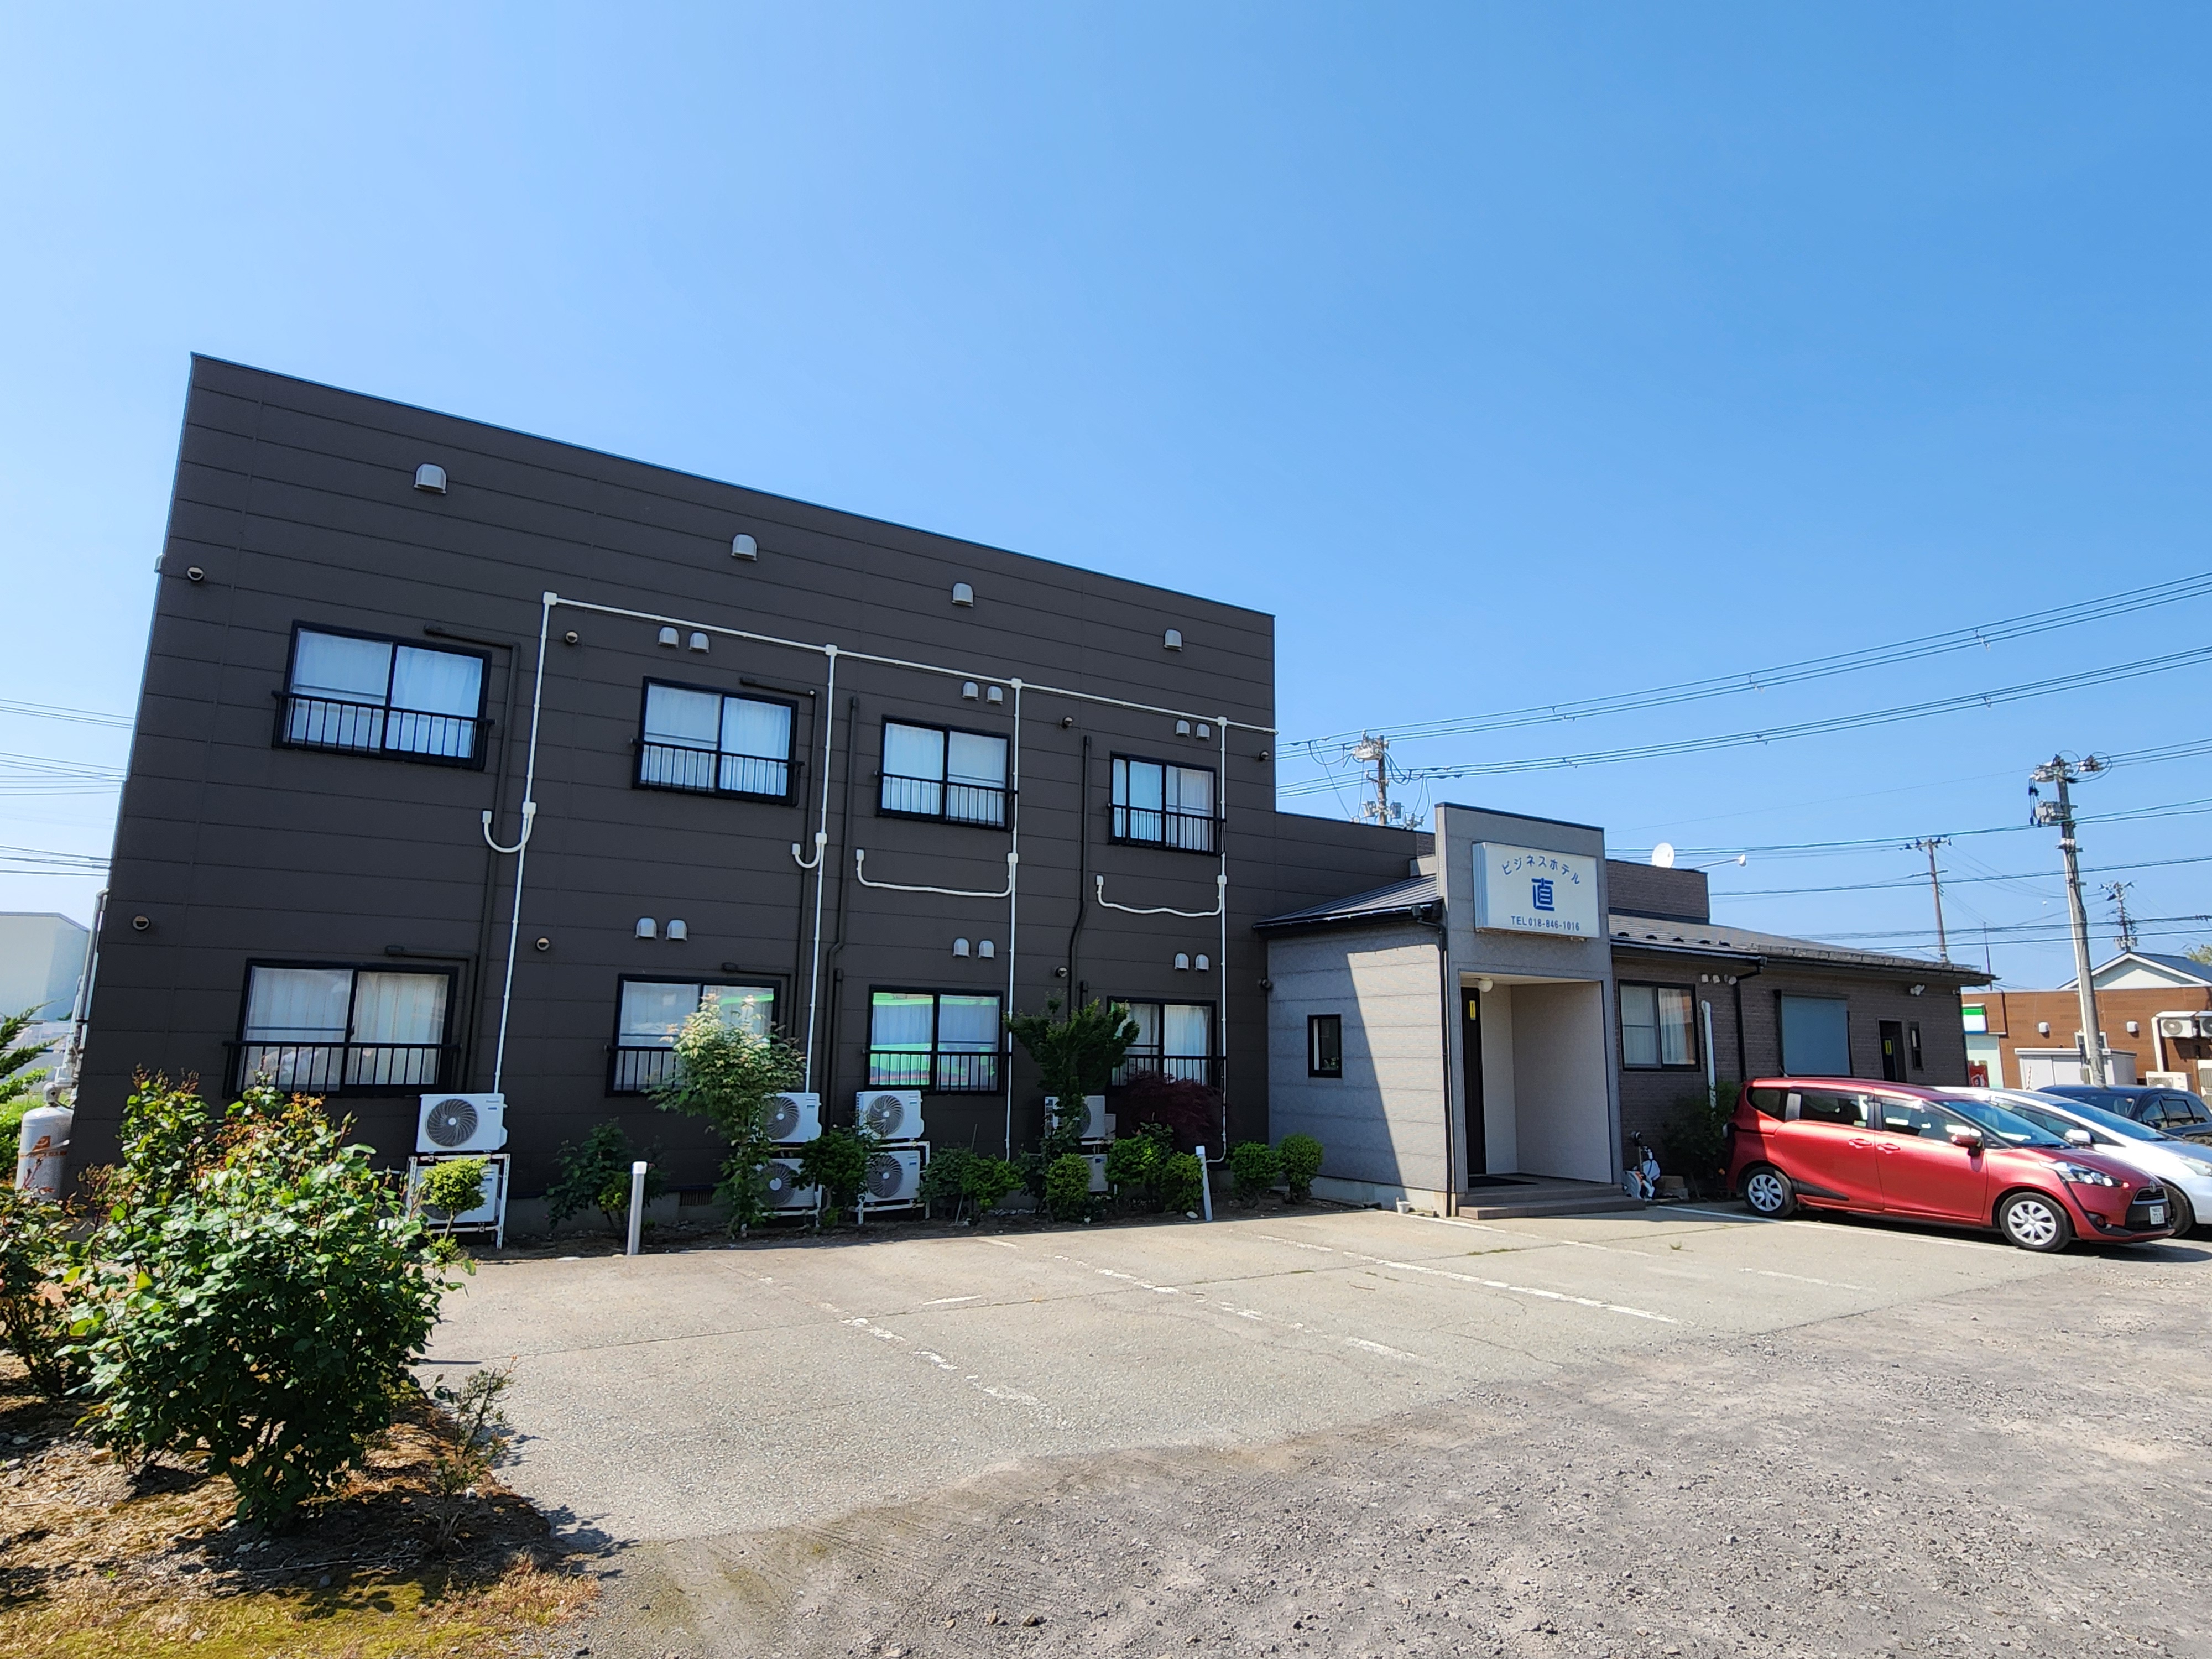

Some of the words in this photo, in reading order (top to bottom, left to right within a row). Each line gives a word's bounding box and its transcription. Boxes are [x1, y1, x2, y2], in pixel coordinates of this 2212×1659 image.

[1501, 854, 1580, 885] ビジネスホテル
[1531, 877, 1555, 911] 直
